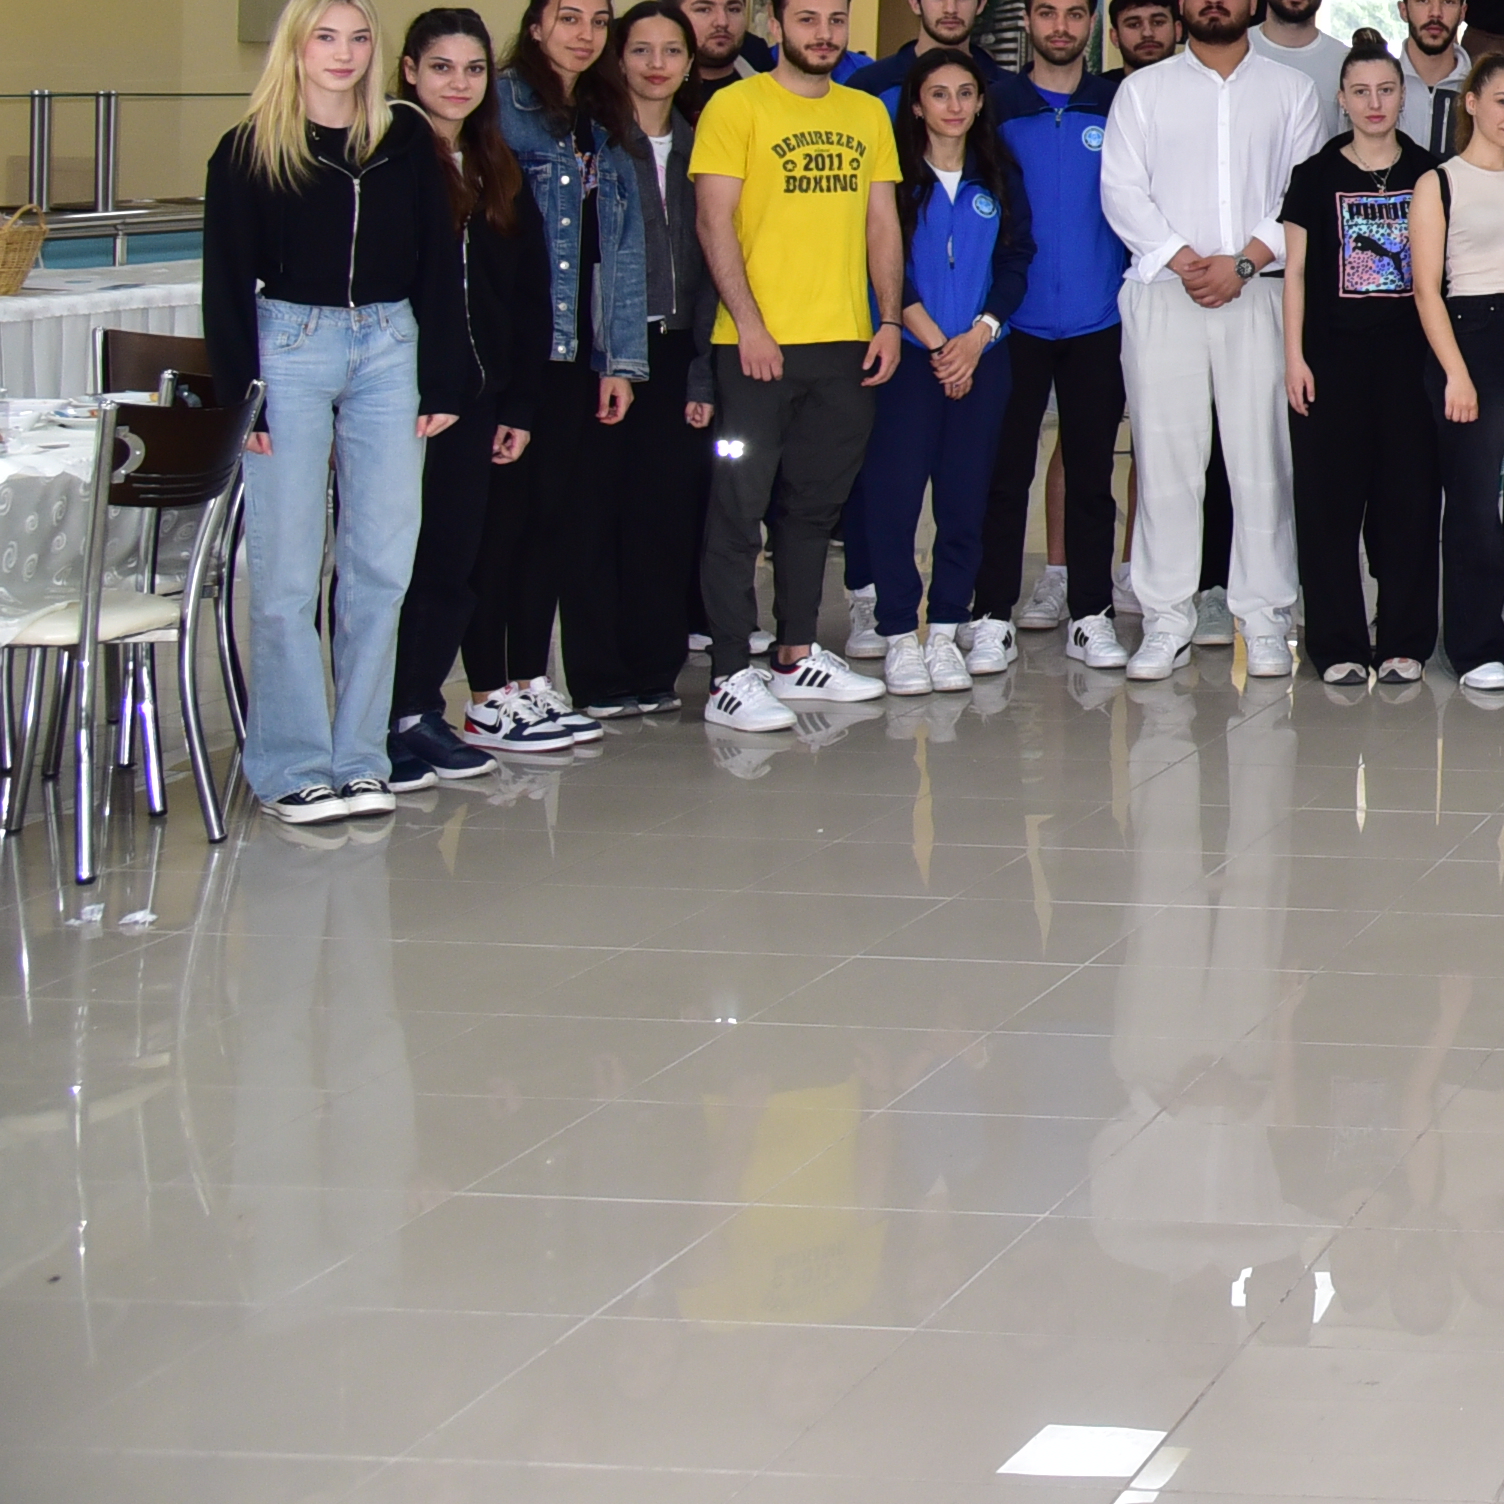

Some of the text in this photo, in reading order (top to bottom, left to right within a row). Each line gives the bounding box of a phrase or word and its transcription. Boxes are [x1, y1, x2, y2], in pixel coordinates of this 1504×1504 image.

[771, 130, 867, 159] DEMIREZEN
[802, 152, 844, 172] 2011
[783, 173, 858, 193] BOXING
